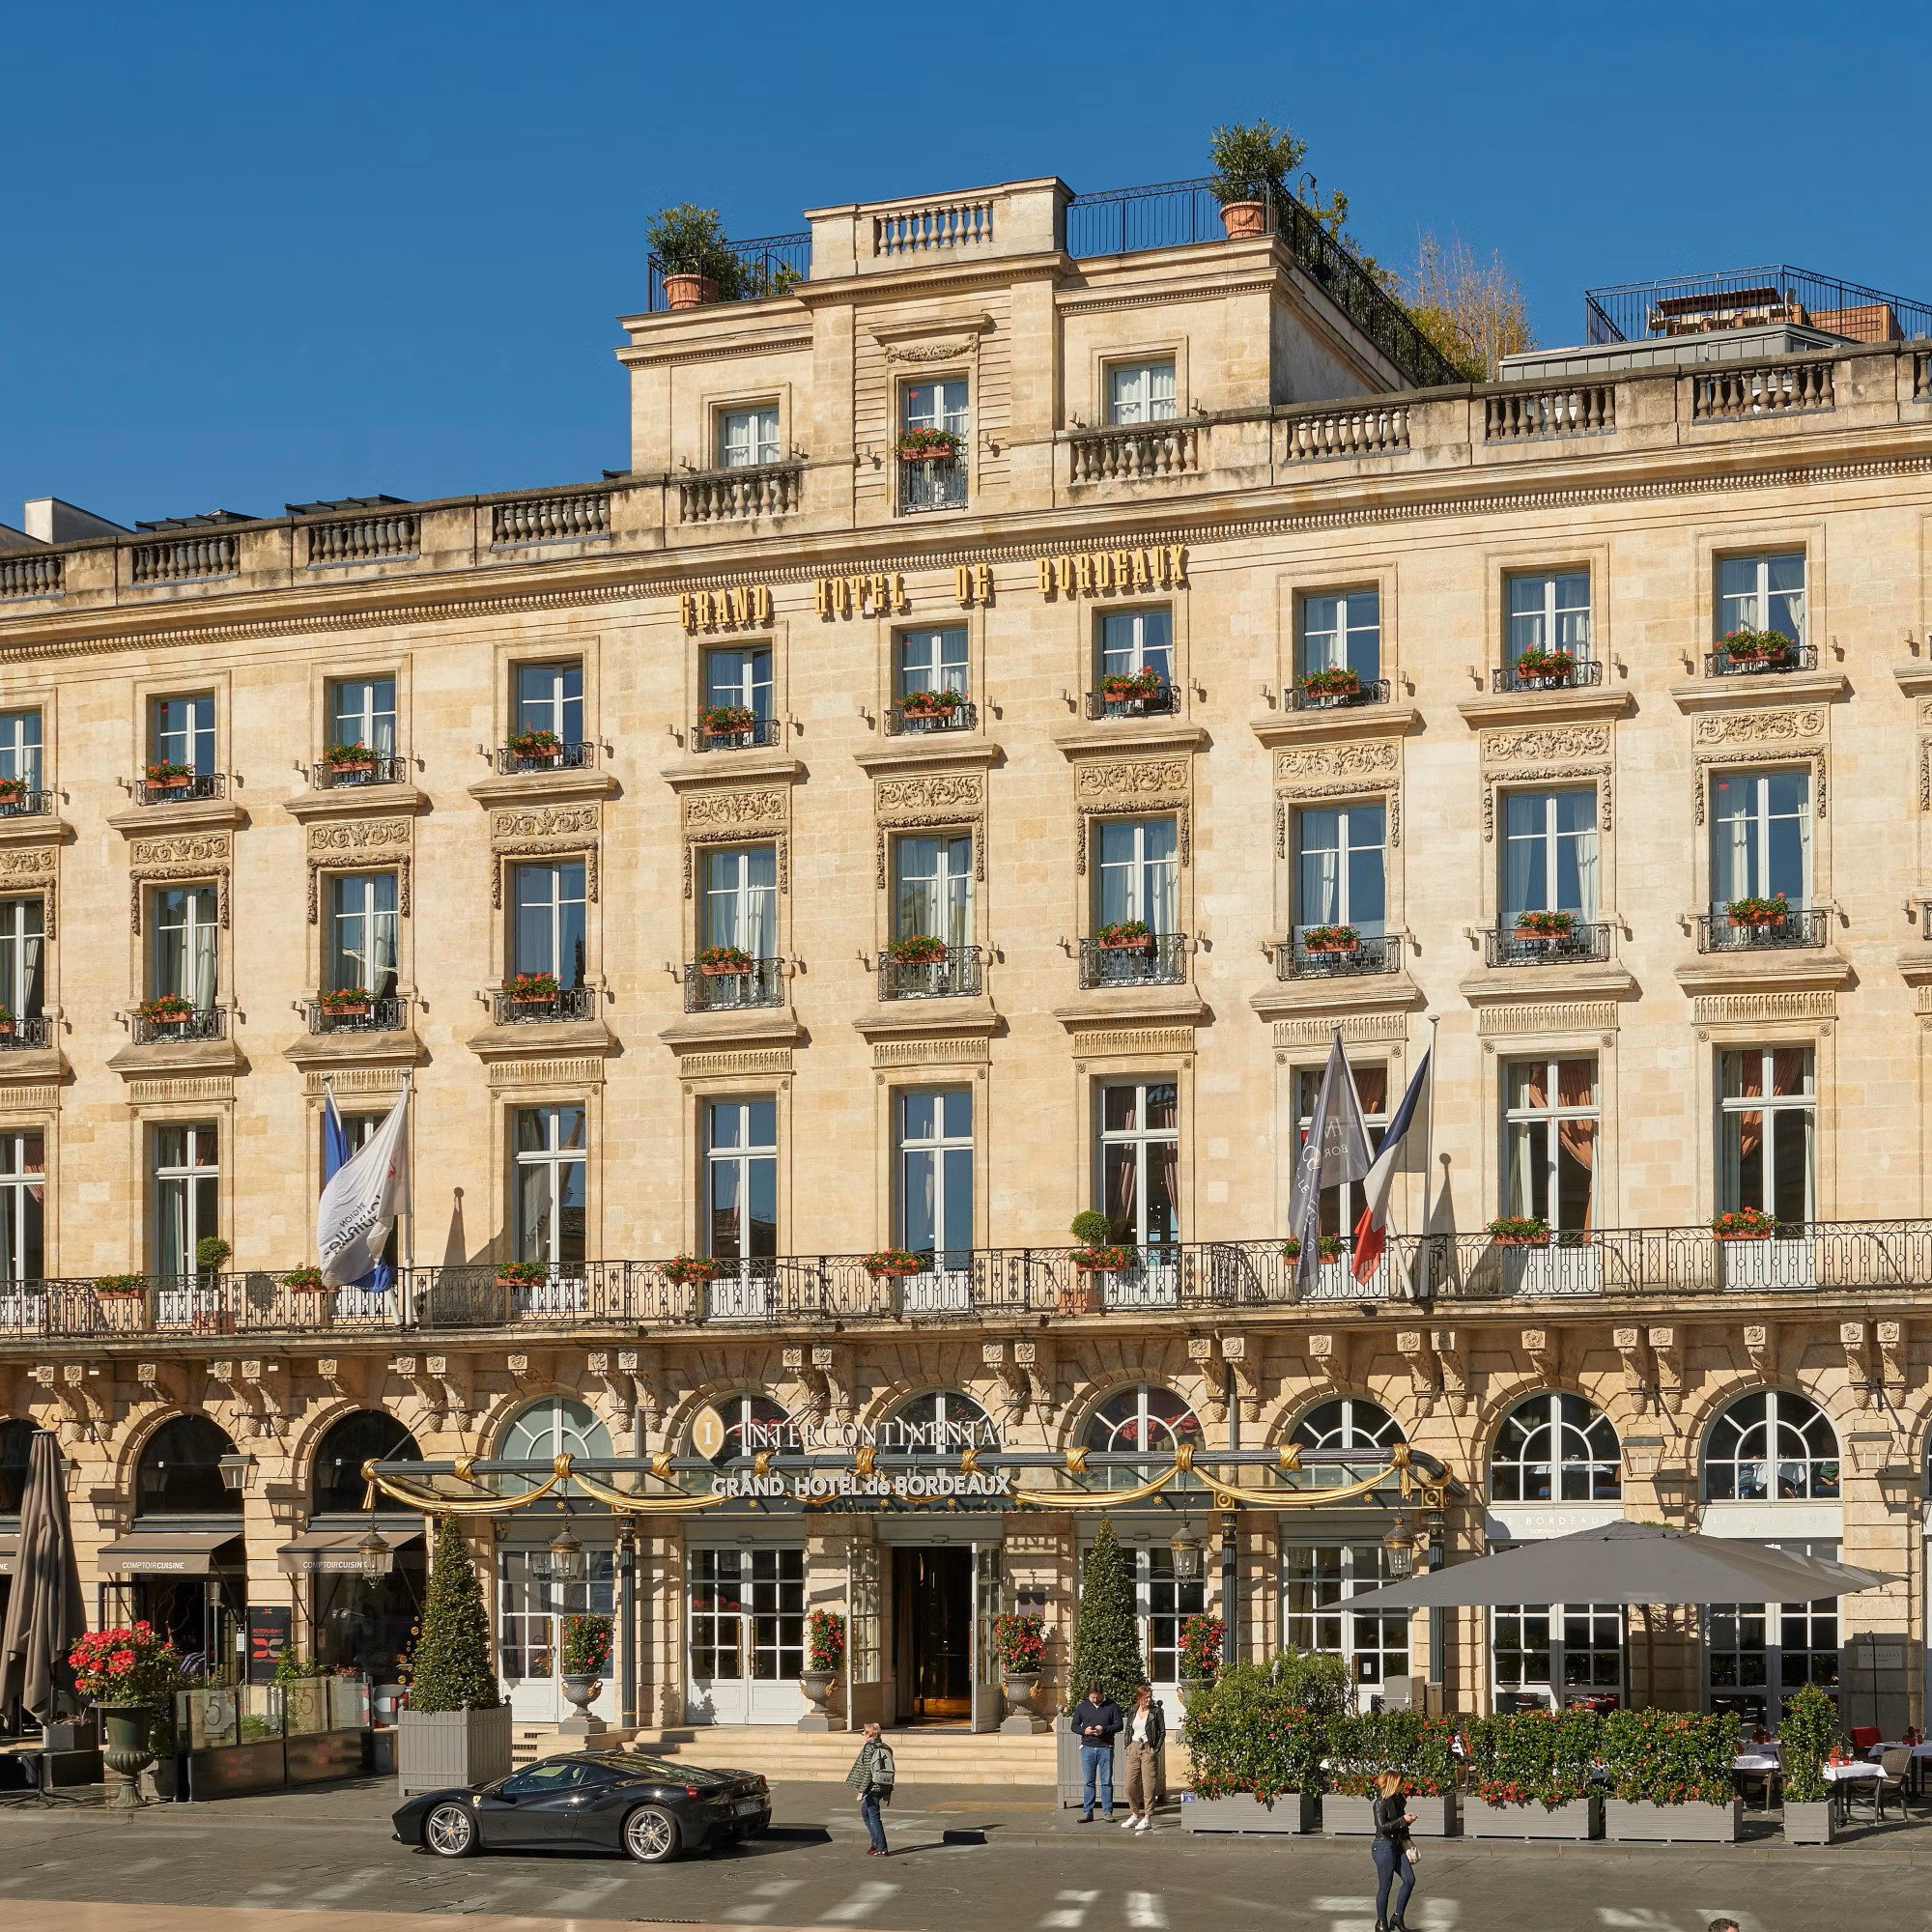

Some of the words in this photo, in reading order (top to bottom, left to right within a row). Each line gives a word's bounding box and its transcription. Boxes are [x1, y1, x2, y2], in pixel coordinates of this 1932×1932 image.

[678, 583, 769, 627] GRAND
[814, 571, 905, 613] HOTEL
[952, 562, 988, 601] DE
[1037, 543, 1184, 593] BORDEAUX
[742, 1420, 1008, 1448] INTERCONTINENTAL
[711, 1477, 784, 1496] GRAND
[794, 1476, 862, 1495] HOTEL
[866, 1476, 891, 1495] de
[895, 1475, 1011, 1495] BORDEAUX
[1525, 1516, 1610, 1525] BORDEAUX
[122, 1561, 185, 1570] COMPTOIRCUISINE
